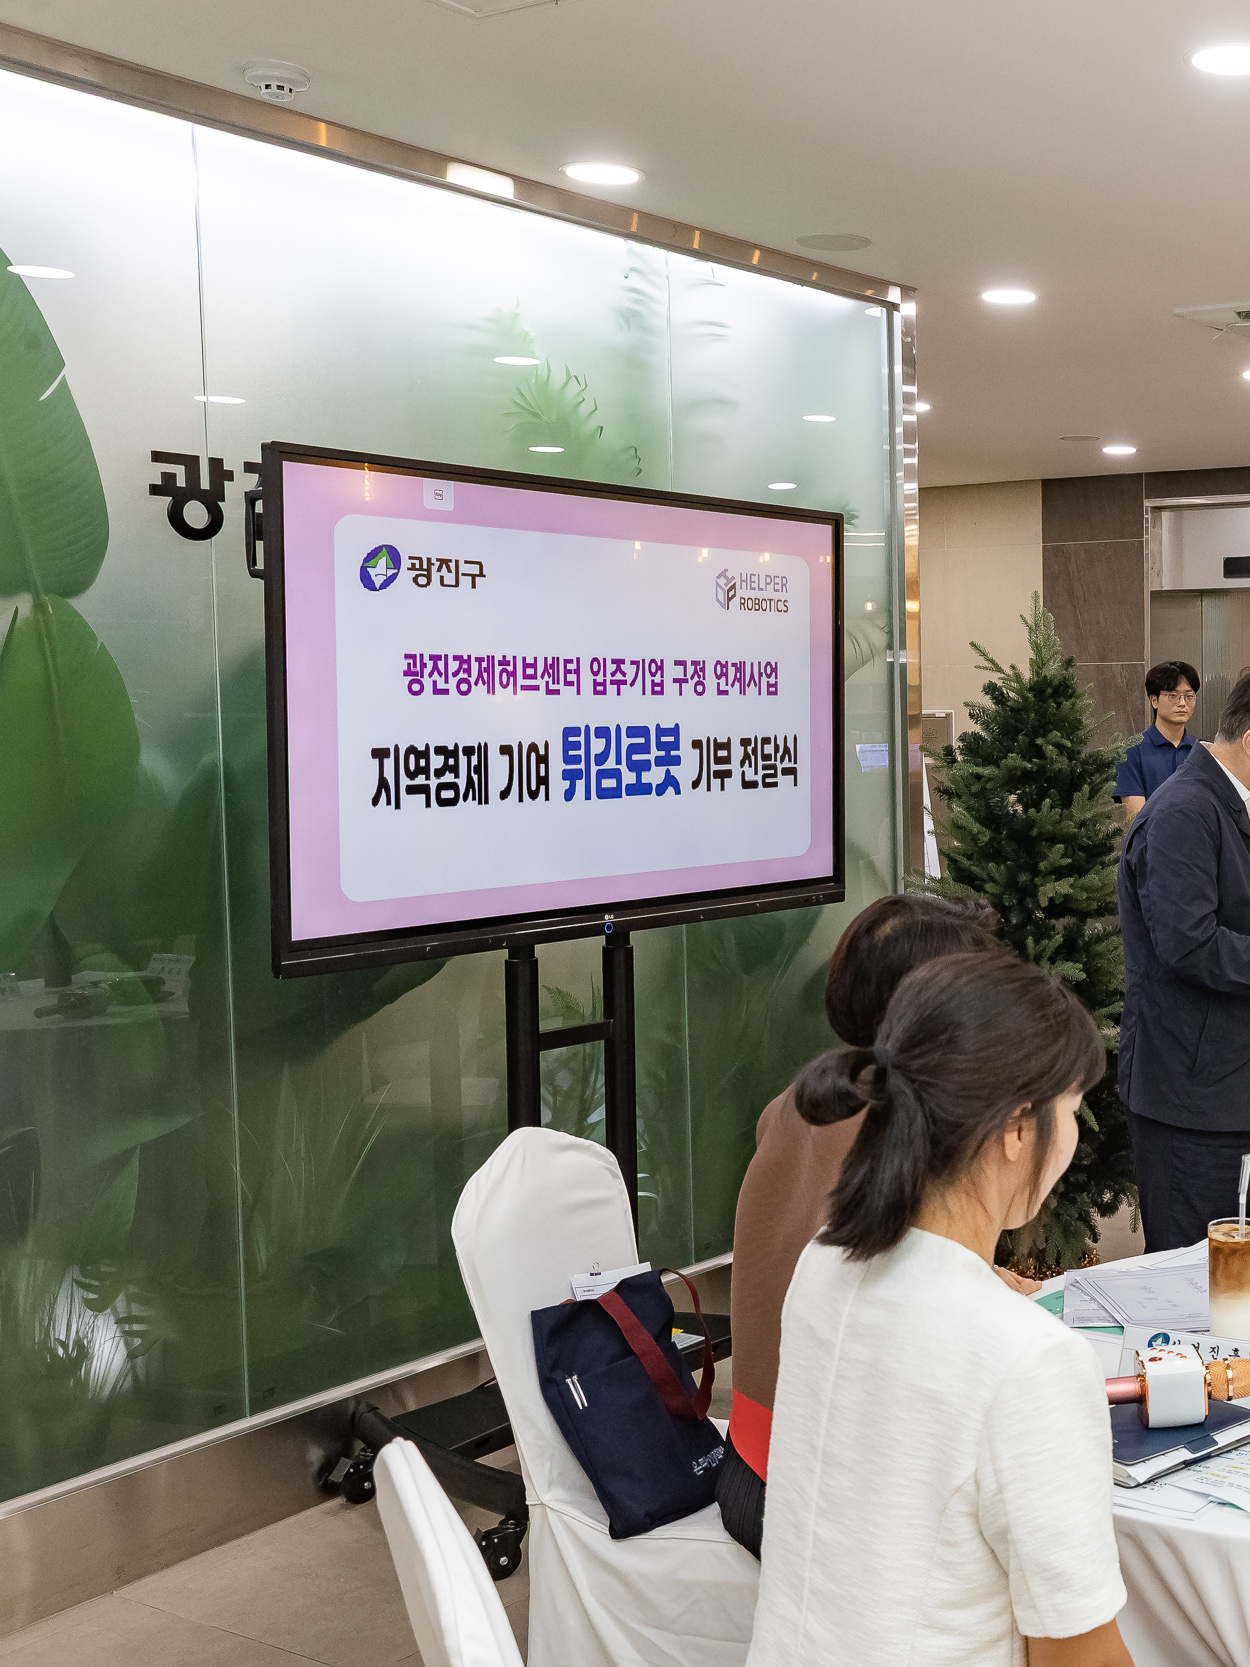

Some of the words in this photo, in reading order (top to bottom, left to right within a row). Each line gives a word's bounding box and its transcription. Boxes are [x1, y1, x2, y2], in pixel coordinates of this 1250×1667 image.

[149, 450, 262, 541] 광
[406, 553, 486, 589] 광진구
[739, 572, 788, 593] HELPER
[739, 596, 789, 614] ROBOTICS
[402, 653, 582, 697] 광진경제허브센터
[589, 657, 665, 696] 입주기업
[671, 660, 707, 696] 구정
[714, 660, 779, 696] 연계사업
[370, 742, 490, 811] 지역경제
[499, 738, 550, 803] 기여
[560, 722, 681, 803] 튀김로봇
[690, 735, 734, 794] 기부
[739, 733, 798, 789] 전달식
